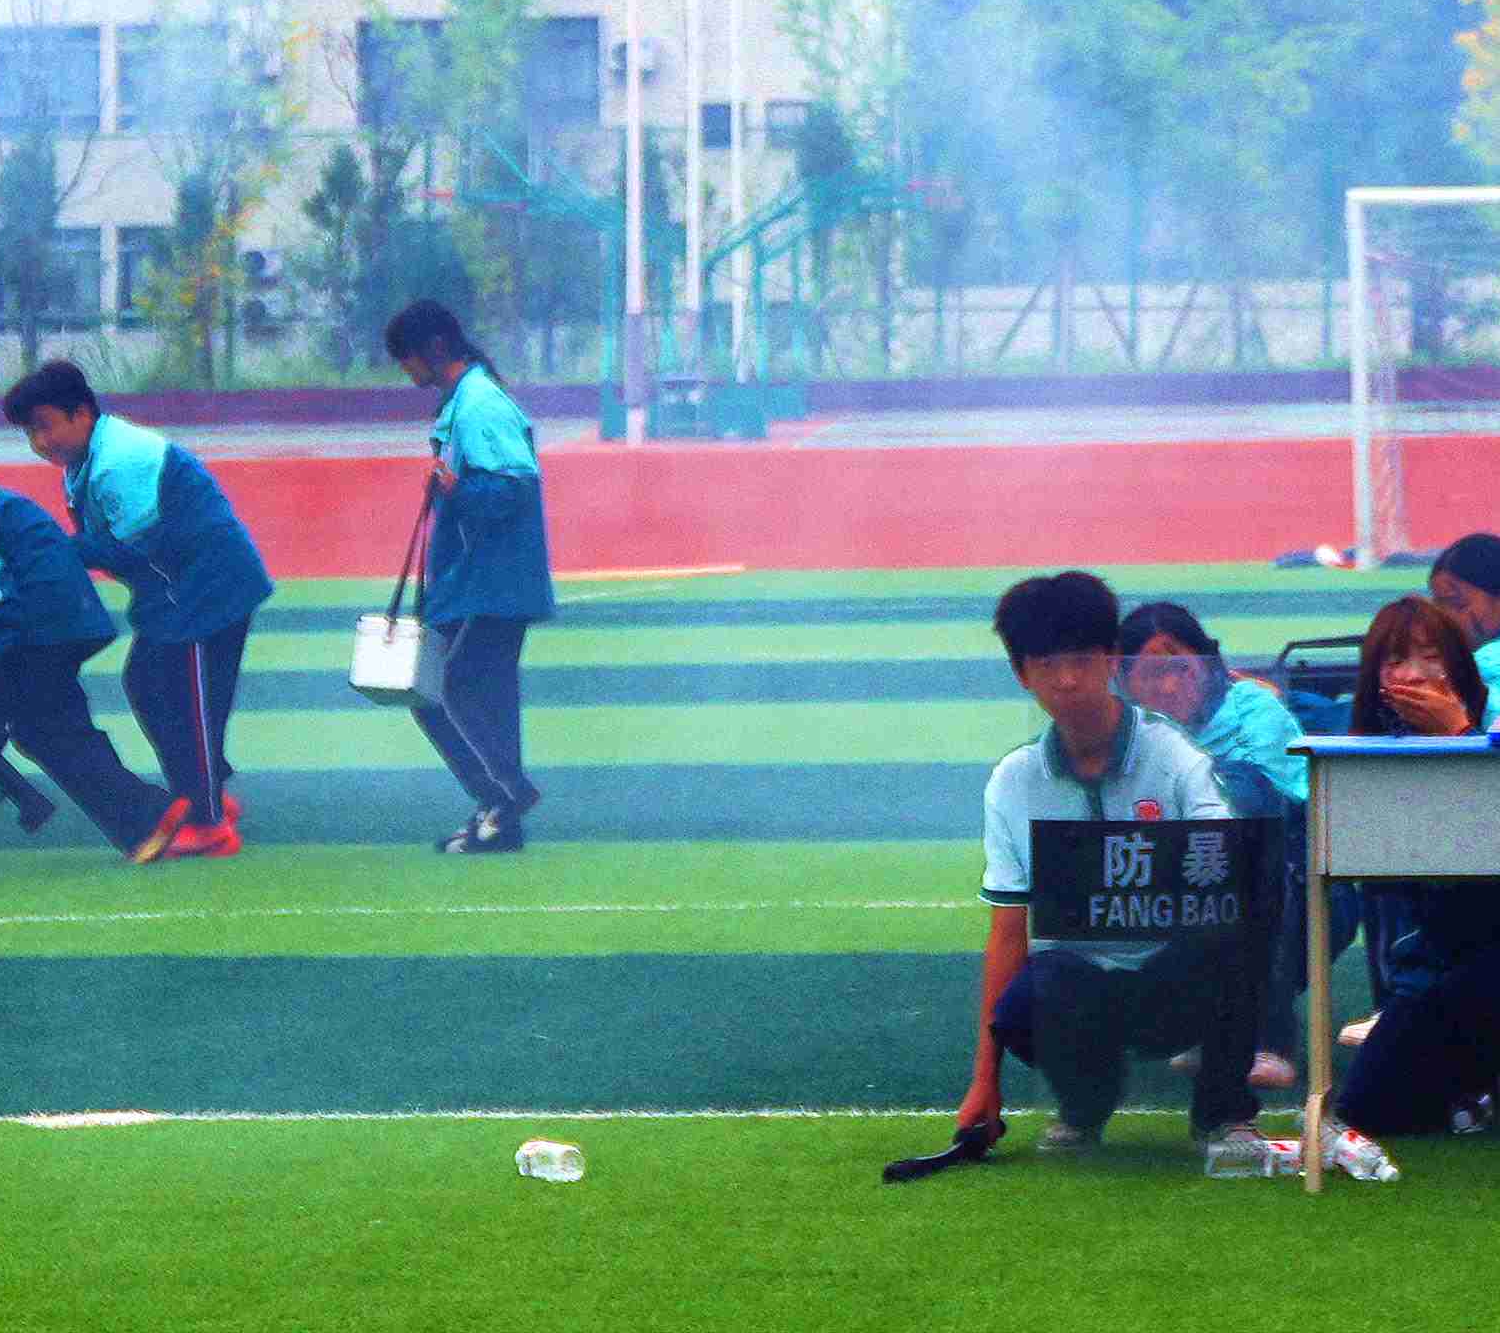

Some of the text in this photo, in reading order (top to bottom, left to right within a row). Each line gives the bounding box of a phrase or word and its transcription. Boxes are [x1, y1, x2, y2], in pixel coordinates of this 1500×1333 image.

[1104, 832, 1229, 888] 防暴
[1089, 892, 1240, 928] FANG BAO
